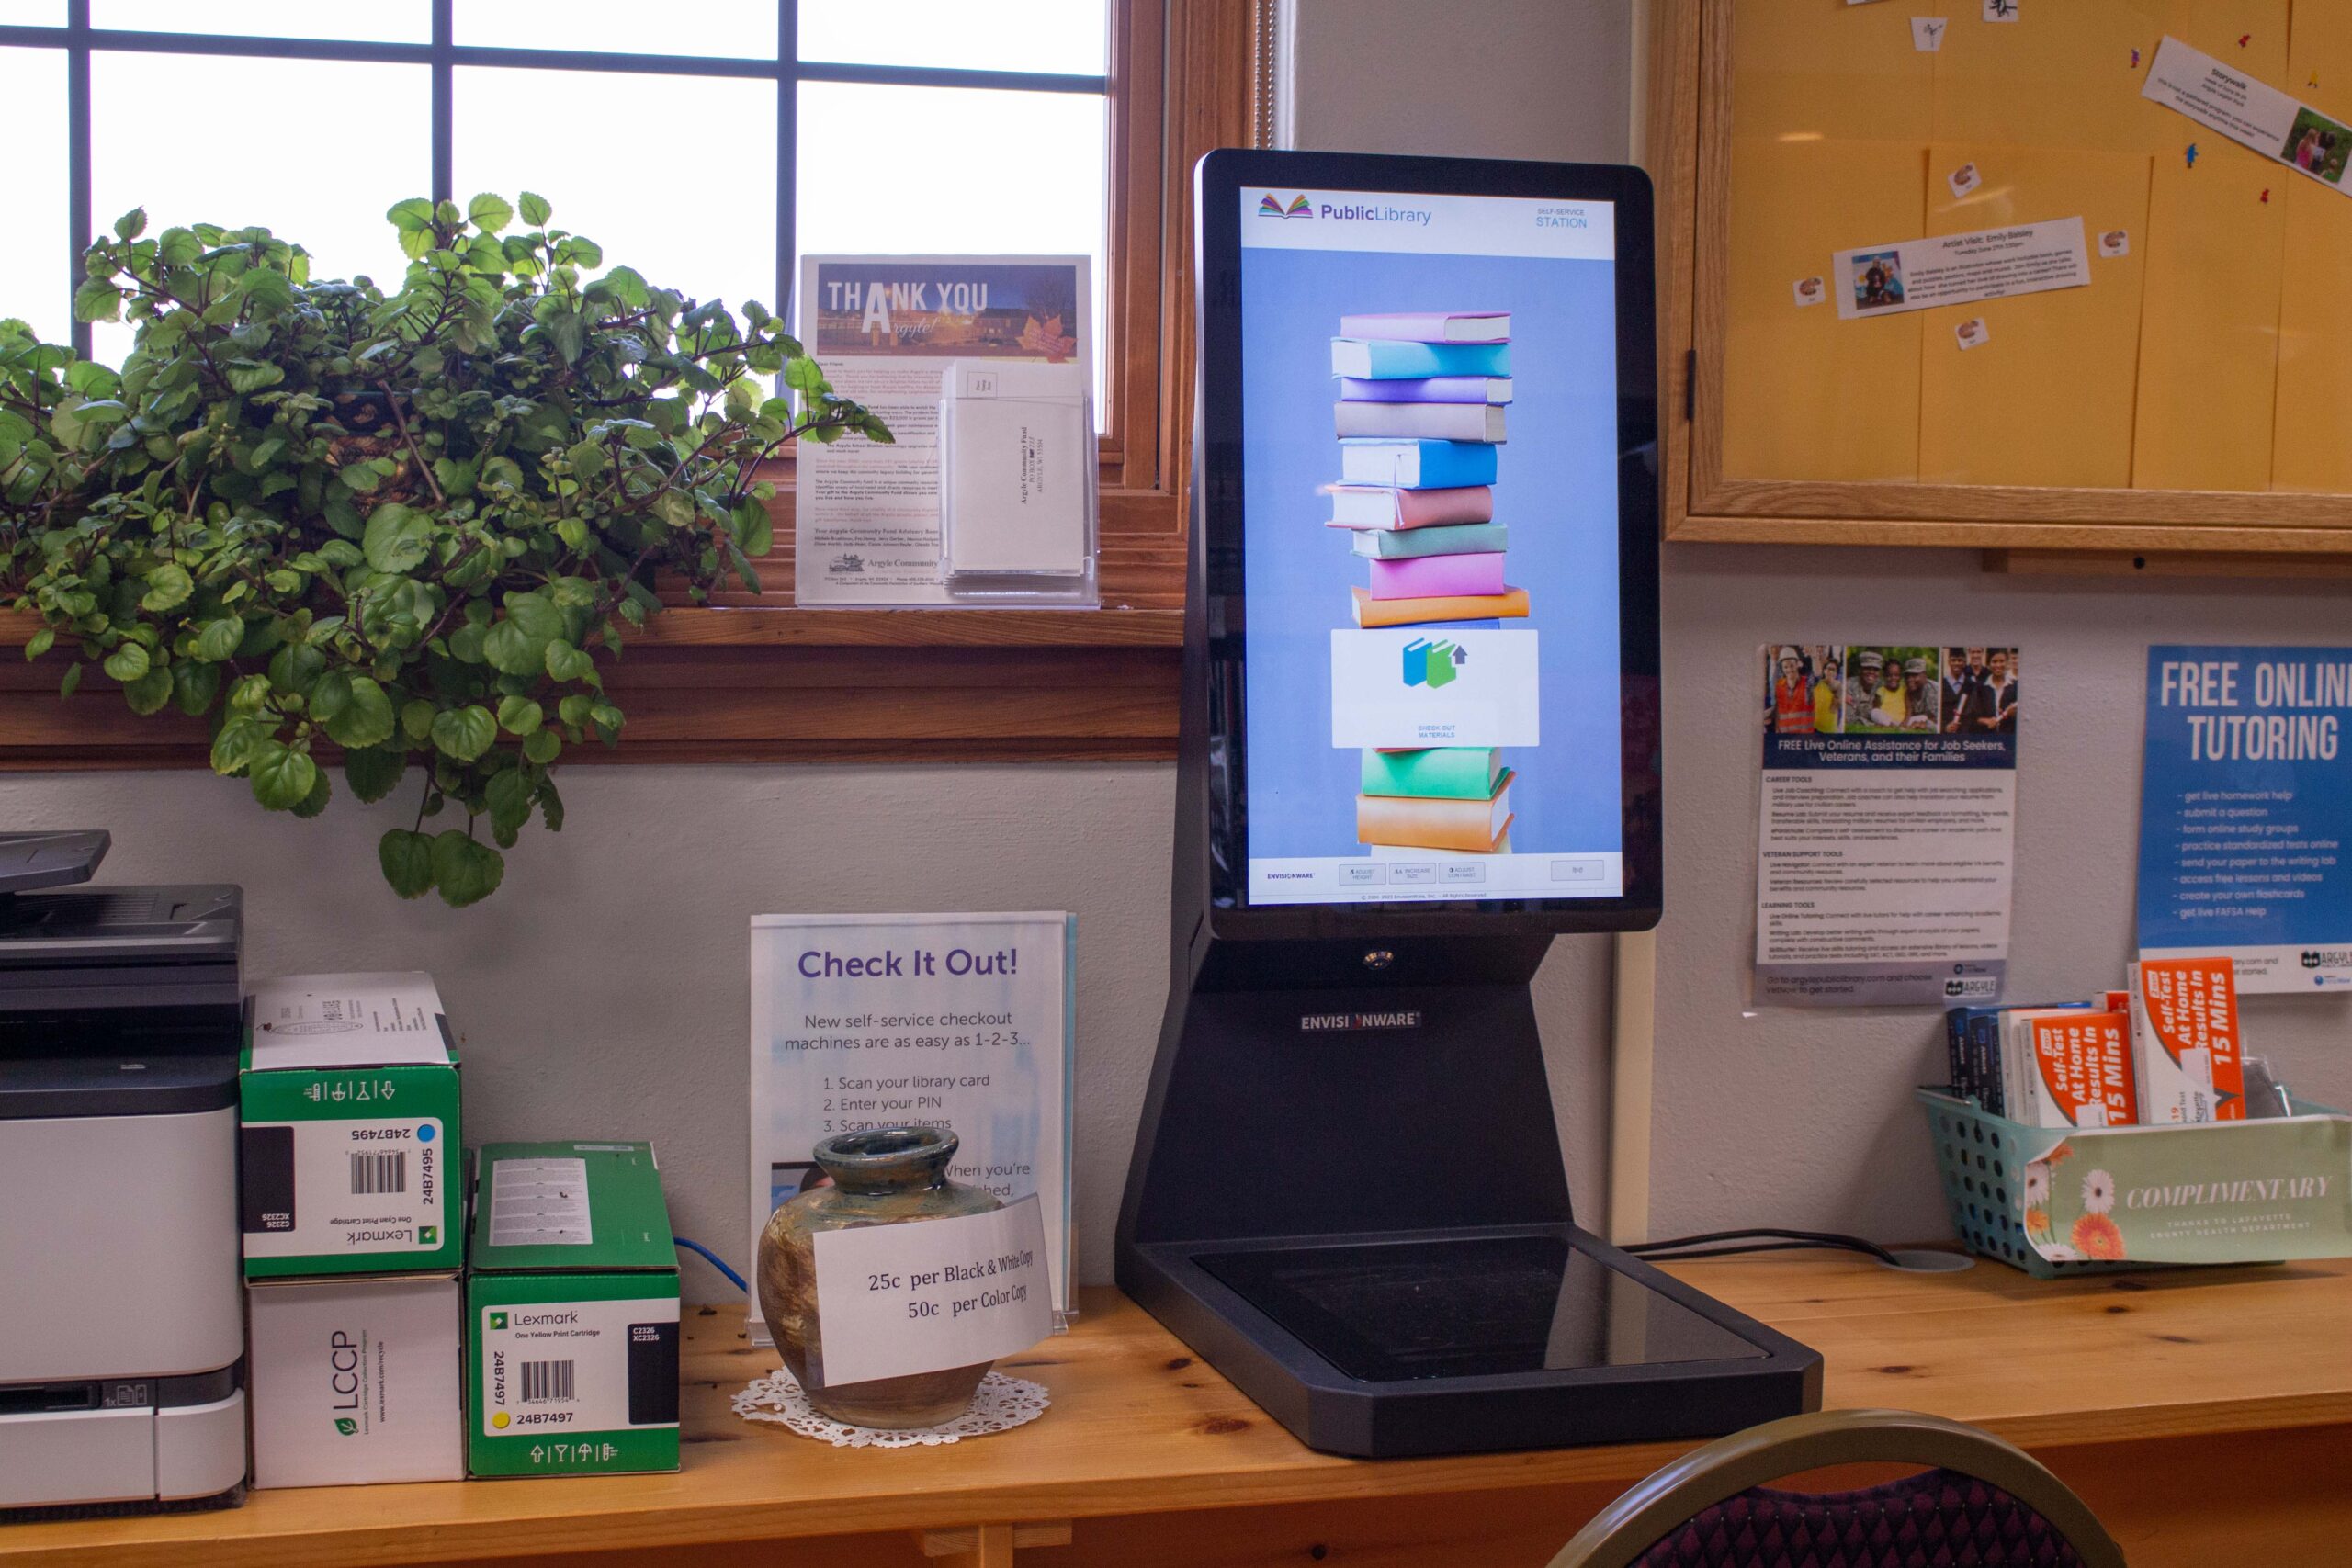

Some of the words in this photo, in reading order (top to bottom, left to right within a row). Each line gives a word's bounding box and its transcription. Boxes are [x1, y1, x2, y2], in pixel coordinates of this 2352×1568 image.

[1321, 204, 1431, 226] PublicLibrary
[1537, 208, 1585, 217] SELF-SERVICE
[1535, 216, 1588, 229] STATION
[828, 282, 927, 333] THANK
[936, 282, 988, 311] YOU
[867, 559, 893, 569] Argyle
[2161, 662, 2239, 707] FREE
[2255, 662, 2352, 707] ONLIN
[1778, 740, 1802, 750] FREE
[1804, 739, 1825, 750] Live
[1827, 739, 1861, 750] Online
[1864, 740, 1921, 750] Assistance
[1924, 740, 1939, 750] for
[1940, 740, 1961, 750] Job
[1962, 740, 2006, 751] Seekers,
[2188, 716, 2339, 761] TUTORING
[1819, 752, 1870, 763] Veterans,
[1871, 752, 1893, 762] and
[1895, 751, 1919, 762] their
[1922, 751, 1965, 762] Families
[2272, 791, 2293, 801] help
[2310, 840, 2338, 849] online
[2206, 860, 2228, 869] your
[2229, 859, 2257, 868] paper
[798, 950, 903, 978] Check
[914, 950, 935, 976] It
[945, 948, 1017, 976] Out!
[2190, 970, 2204, 987] In
[2159, 970, 2176, 1034] Self-Test
[2177, 970, 2190, 1022] Home
[2209, 972, 2229, 1032] Mins
[805, 1014, 841, 1028] New
[845, 1012, 934, 1028] self-service
[939, 1011, 1012, 1026] checkout
[2191, 990, 2209, 1050] Results
[785, 1036, 860, 1050] machines
[865, 1038, 889, 1048] are
[894, 1037, 910, 1048] as
[915, 1037, 950, 1051] easy
[954, 1036, 970, 1046] as
[975, 1032, 1030, 1046] 1-2-3...
[2083, 1026, 2097, 1044] In
[2178, 1027, 2192, 1046] At
[2052, 1028, 2068, 1091] Self-Test
[2069, 1027, 2084, 1079] Home
[2101, 1028, 2124, 1088] Mins
[2212, 1036, 2233, 1066] 15
[823, 1077, 834, 1090] 1.
[839, 1077, 873, 1089] Scan
[876, 1078, 908, 1092] your
[912, 1075, 956, 1090] library
[959, 1074, 990, 1087] card
[2085, 1047, 2102, 1105] Results
[2071, 1082, 2086, 1103] At
[823, 1099, 835, 1111] 2.
[841, 1099, 878, 1111] Enter
[881, 1100, 913, 1113] your
[919, 1096, 942, 1109] PIN
[2107, 1092, 2127, 1122] 15
[352, 1128, 411, 1141] 24B7495
[823, 1120, 835, 1133] 3.
[840, 1119, 874, 1132] Scan
[914, 1118, 952, 1130] items
[423, 1148, 433, 1205] 24B7495
[985, 1162, 1031, 1179] you're
[2127, 1175, 2334, 1210] COMPLIMENTARY
[330, 1217, 361, 1225] Cartridge
[2167, 1219, 2209, 1227] THANKS
[2232, 1213, 2291, 1224] LAFAYETTE
[347, 1230, 413, 1245] Lexmark
[2150, 1230, 2191, 1239] COUNTY
[2196, 1227, 2236, 1236] HEALTH
[2242, 1222, 2311, 1233] DEPARTMENT
[868, 1273, 900, 1291] 25c
[910, 1272, 940, 1291] per
[944, 1261, 985, 1282] Black
[987, 1259, 997, 1275] &
[998, 1254, 1020, 1273] White
[1020, 1249, 1034, 1268] Copy
[908, 1301, 940, 1318] 50c
[952, 1298, 978, 1317] per
[981, 1289, 1010, 1308] Color
[1012, 1284, 1027, 1303] Copy
[514, 1311, 579, 1325] Lexmark
[571, 1329, 600, 1337] Cartridge
[332, 1330, 358, 1409] LCCP
[494, 1350, 505, 1406] 24B7497
[377, 1341, 385, 1423] www.lexmark.com/recycle
[516, 1412, 573, 1425] 24B7497
